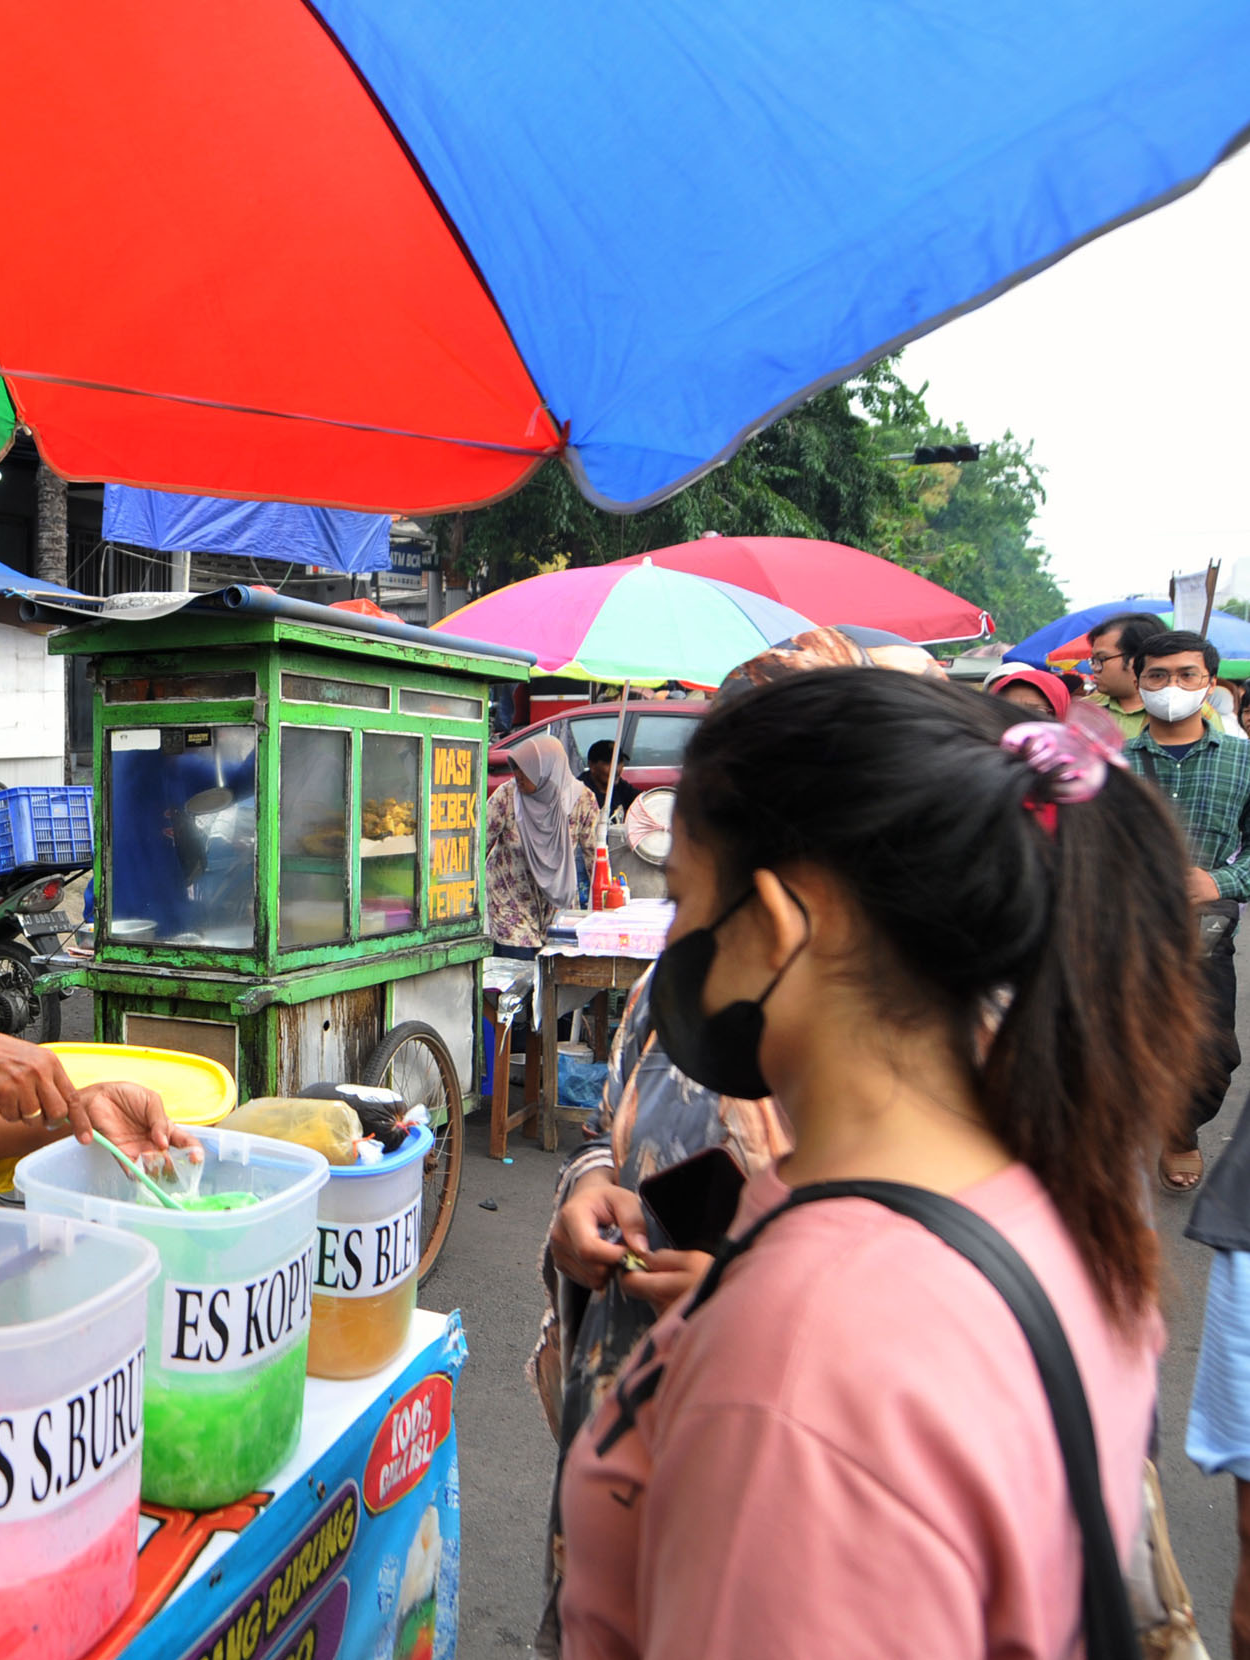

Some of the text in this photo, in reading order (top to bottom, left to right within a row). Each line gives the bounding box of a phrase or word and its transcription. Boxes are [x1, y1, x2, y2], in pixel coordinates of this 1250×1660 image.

[430, 792, 477, 831] BEBEK
[432, 836, 469, 876] AYAM
[428, 880, 476, 920] TEMPE
[313, 1226, 362, 1291] ES
[171, 1287, 230, 1363] ES
[266, 1497, 354, 1634] BURUNG
